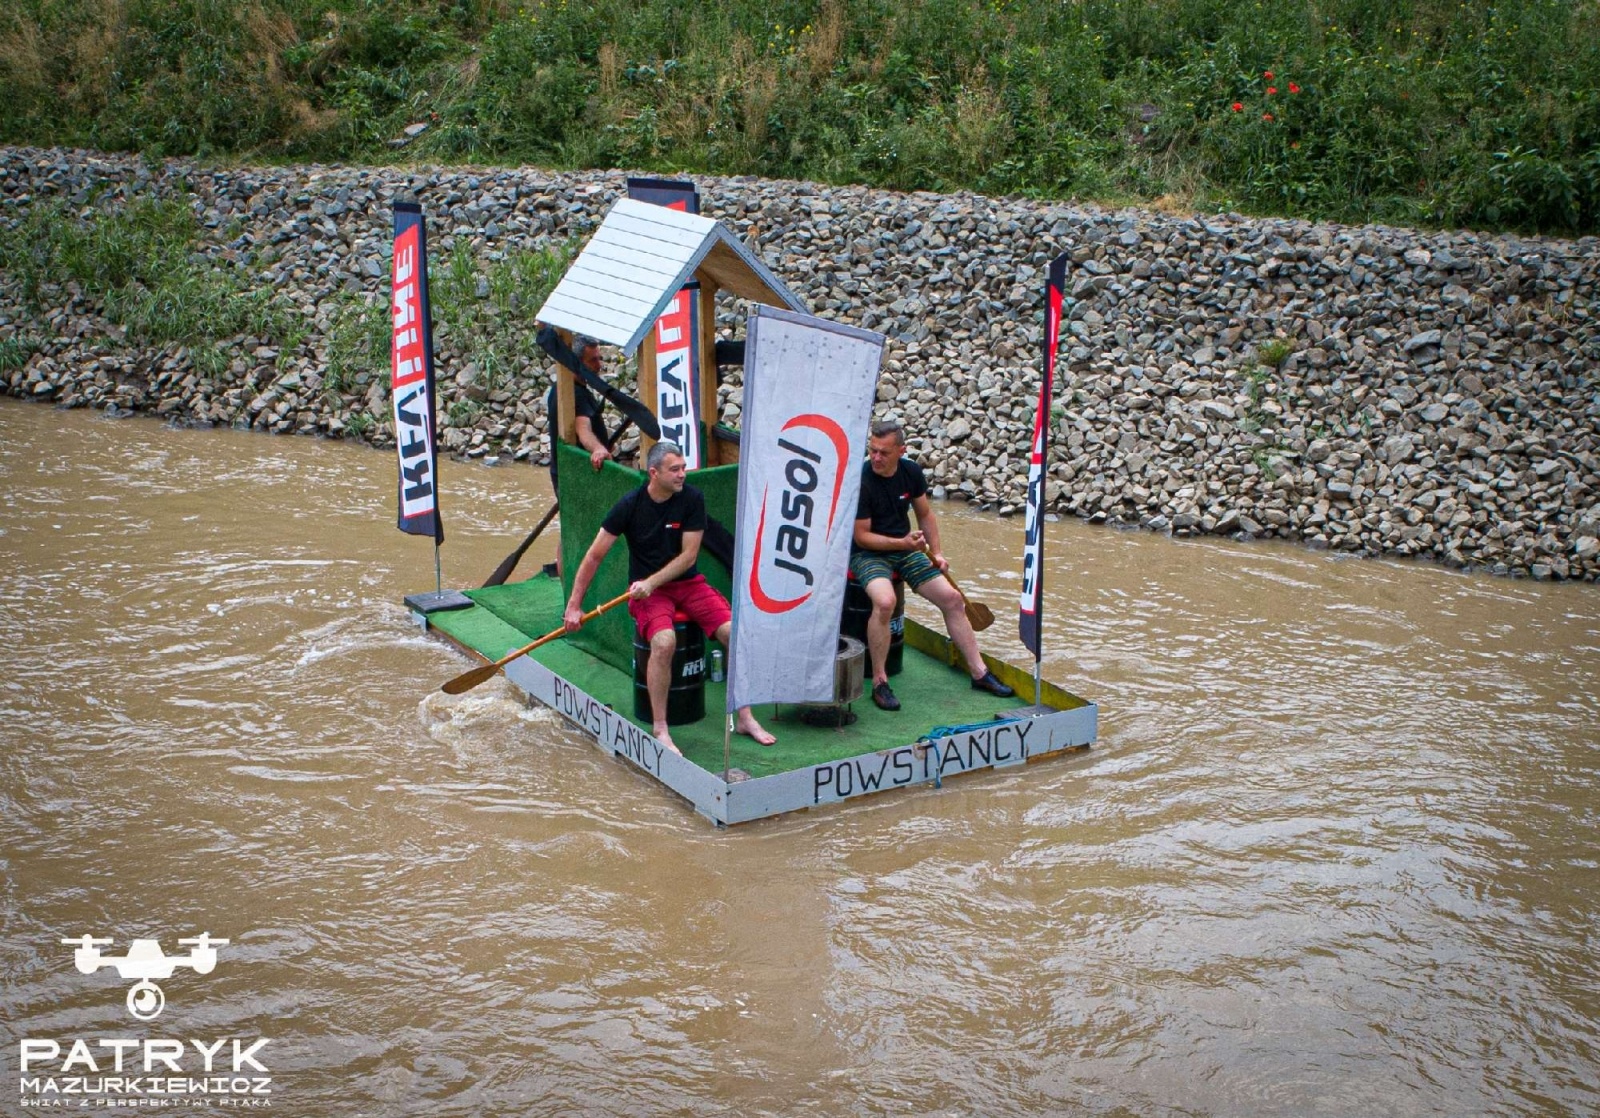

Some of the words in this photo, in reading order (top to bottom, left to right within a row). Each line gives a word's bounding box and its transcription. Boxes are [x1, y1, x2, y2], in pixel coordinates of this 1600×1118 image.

[773, 437, 822, 587] Jasol
[553, 676, 664, 777] POWSTAŃCY
[813, 720, 1034, 804] POWSTAŃCY
